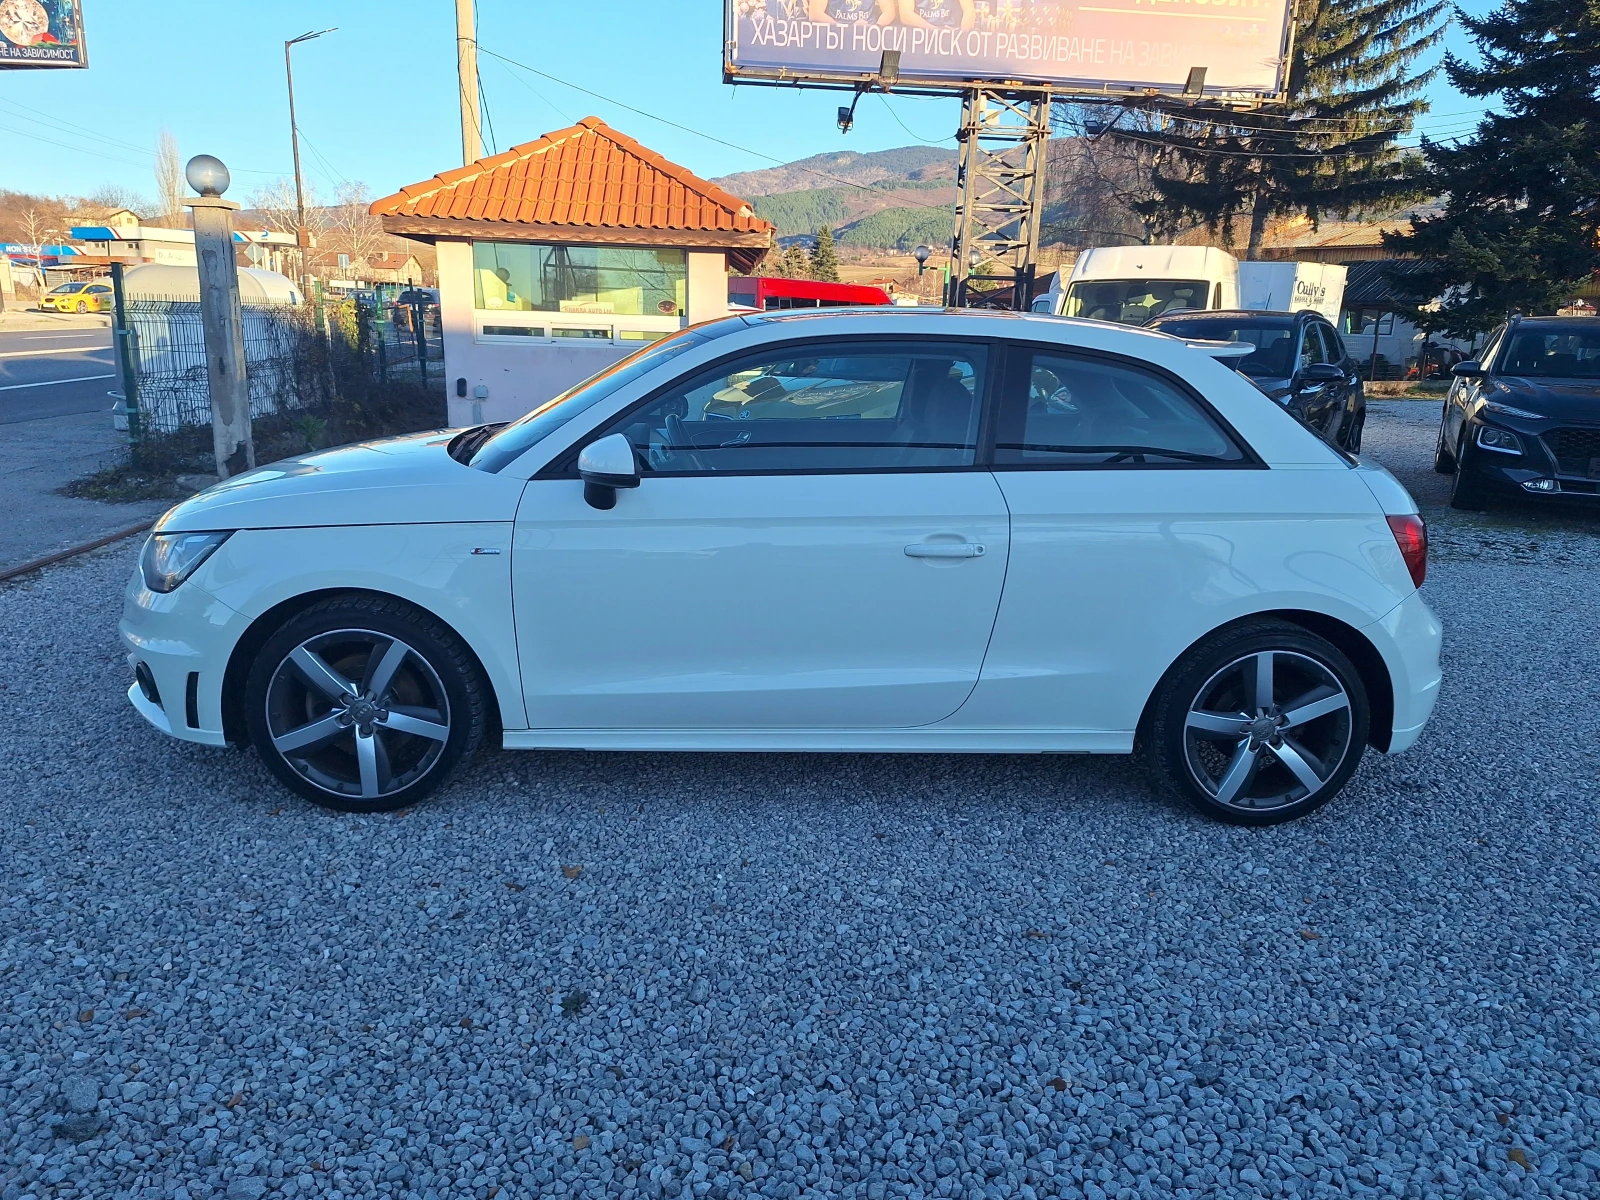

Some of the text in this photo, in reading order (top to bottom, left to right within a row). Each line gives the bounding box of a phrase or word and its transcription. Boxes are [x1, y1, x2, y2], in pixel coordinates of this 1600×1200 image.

[835, 9, 858, 21] PALMS
[920, 8, 940, 18] PALMS
[751, 19, 849, 49] ХАЗАРТЪТ
[852, 24, 907, 52] НОСИ
[911, 27, 962, 56] РИСК
[966, 30, 994, 57] ОТ
[995, 32, 1106, 64] РАЗВИВАНЕ
[1110, 40, 1135, 66] НА
[10, 47, 21, 58] НА
[22, 48, 74, 59] ЗАВИСИМОСТ
